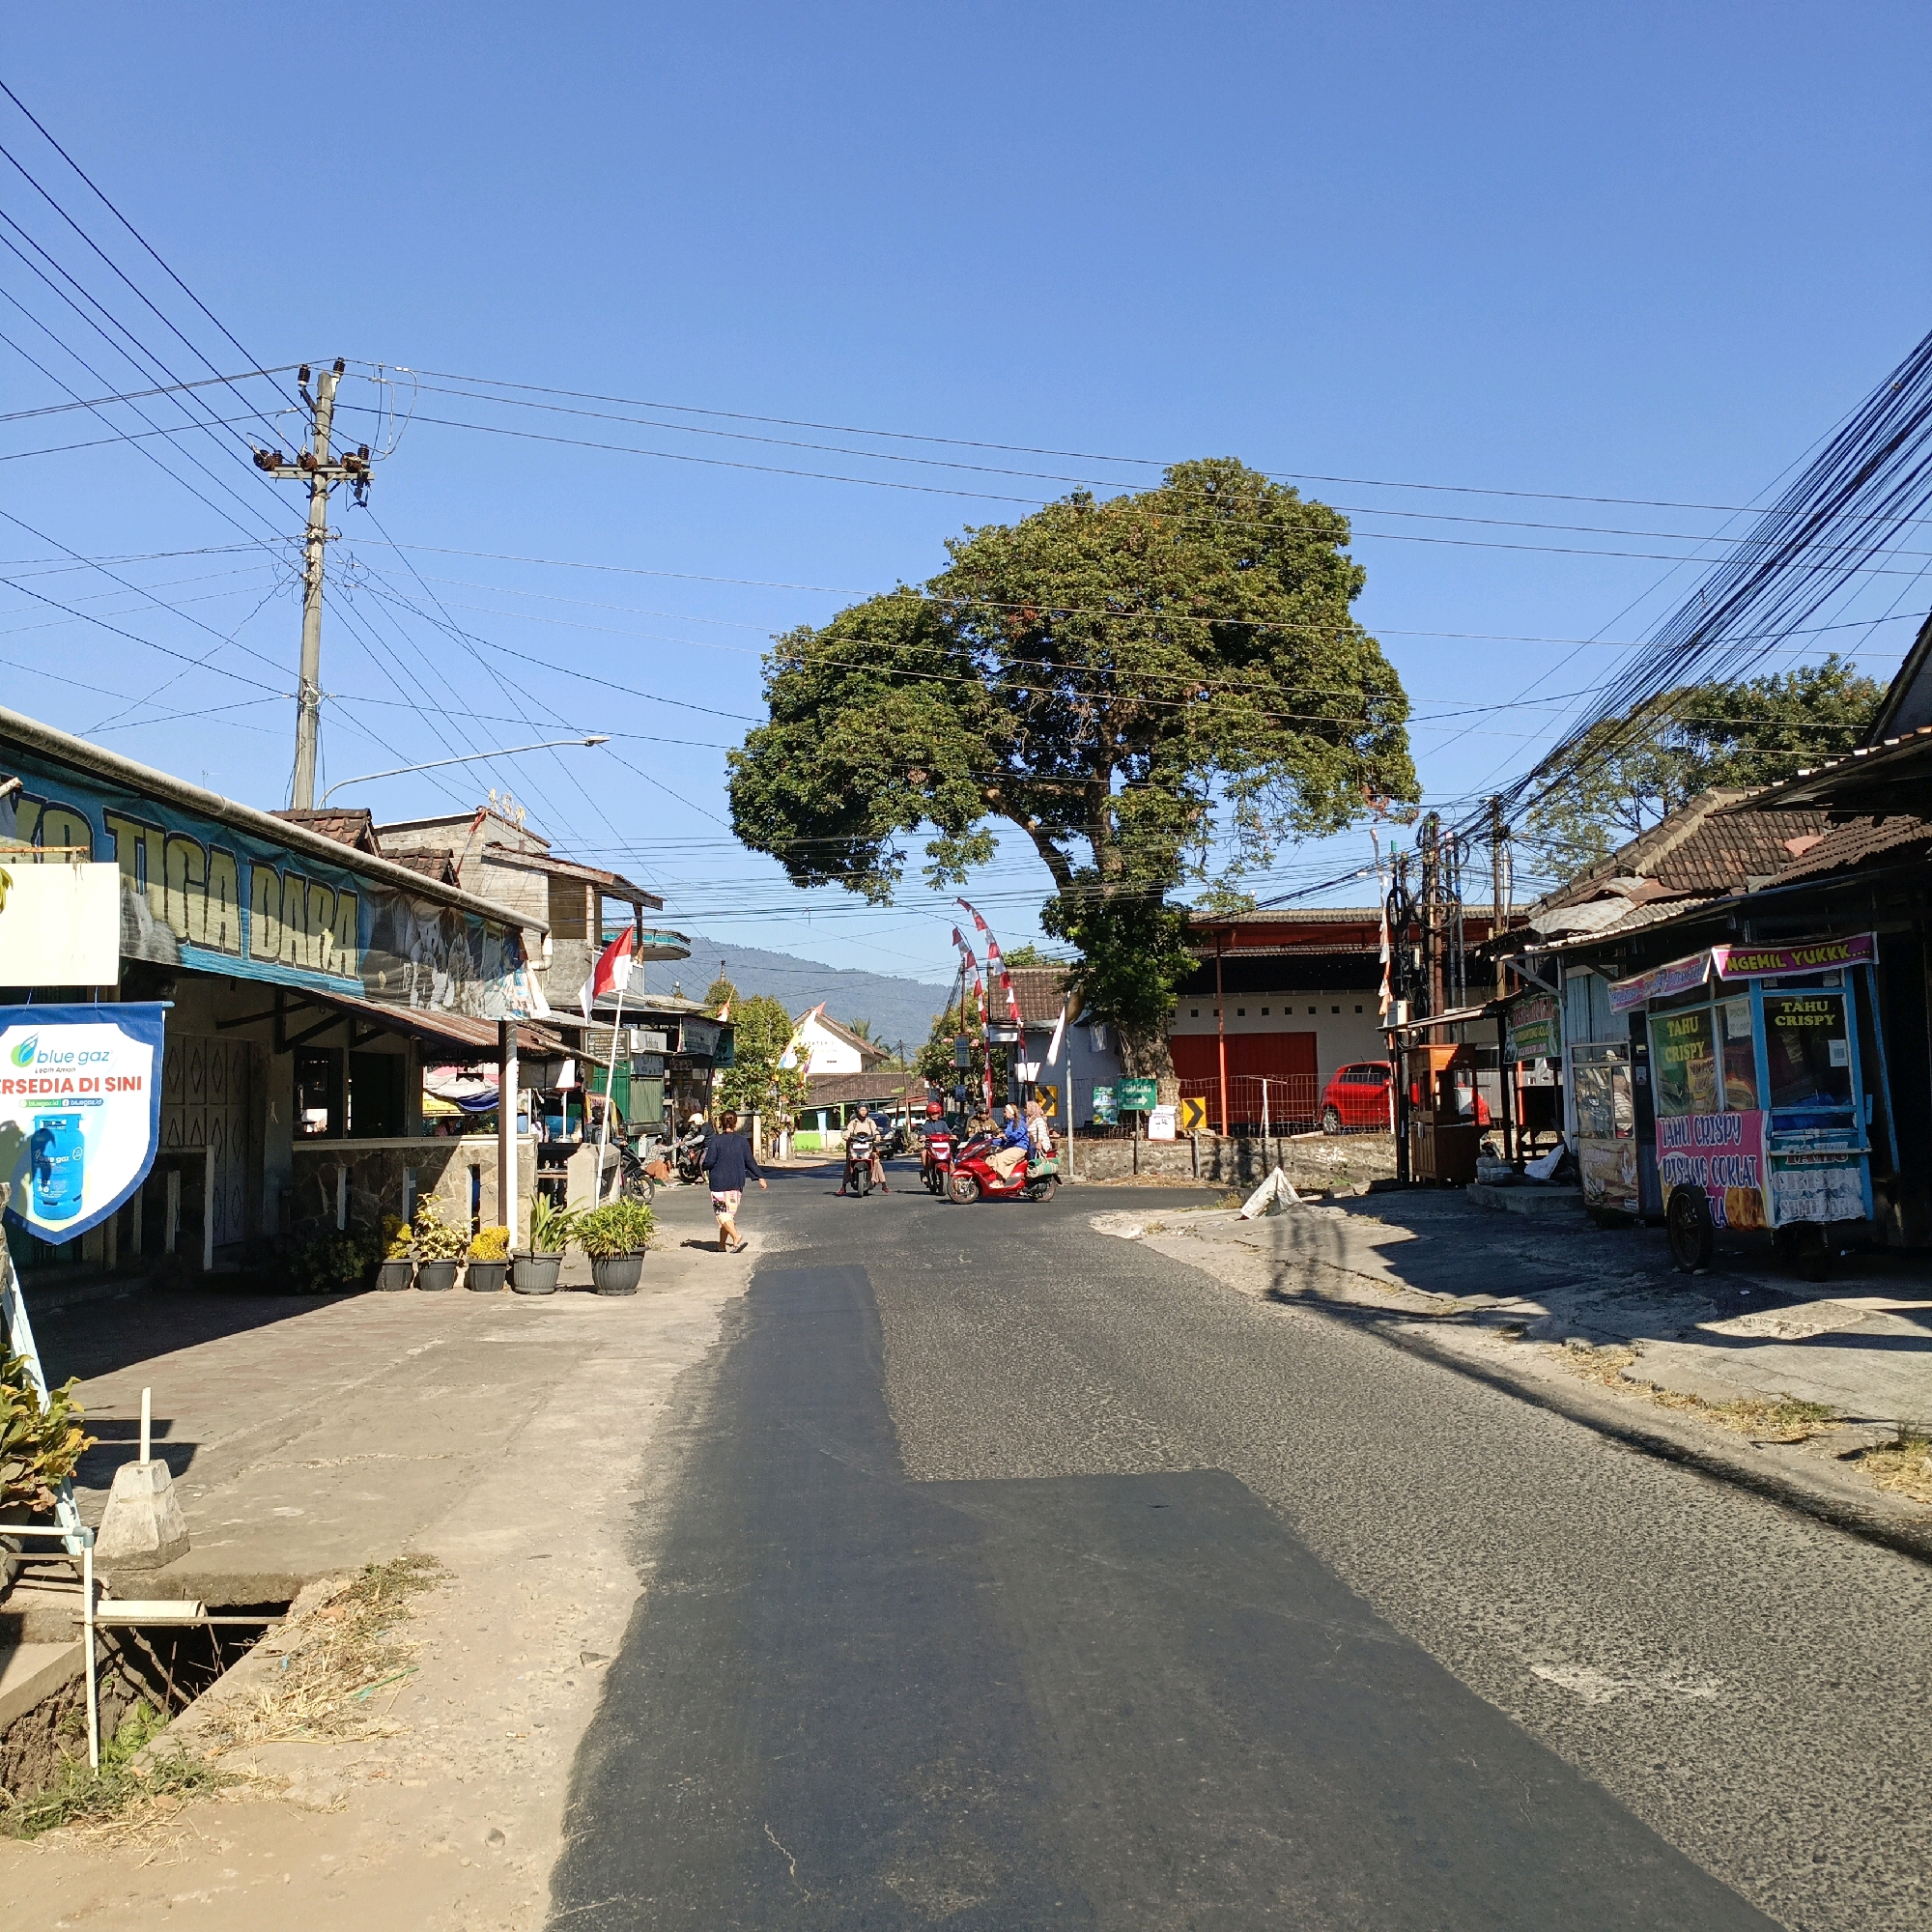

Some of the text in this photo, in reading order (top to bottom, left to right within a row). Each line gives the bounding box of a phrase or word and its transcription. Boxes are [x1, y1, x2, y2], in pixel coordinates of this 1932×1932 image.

[102, 806, 243, 957] TIGA
[247, 857, 361, 981] DARA
[1725, 956, 1787, 973] NGEMIL
[1781, 1001, 1829, 1012] TAHU
[1666, 1016, 1699, 1037] TAHU
[1775, 1014, 1835, 1026] CRISPY
[37, 1050, 110, 1065] blue gaz
[1664, 1041, 1705, 1063] CRISPY
[0, 1076, 142, 1094] RSEDIA DI SINI
[1659, 1113, 1742, 1149] TAHU CRISPY
[1662, 1154, 1758, 1189] PISANG COKLAT
